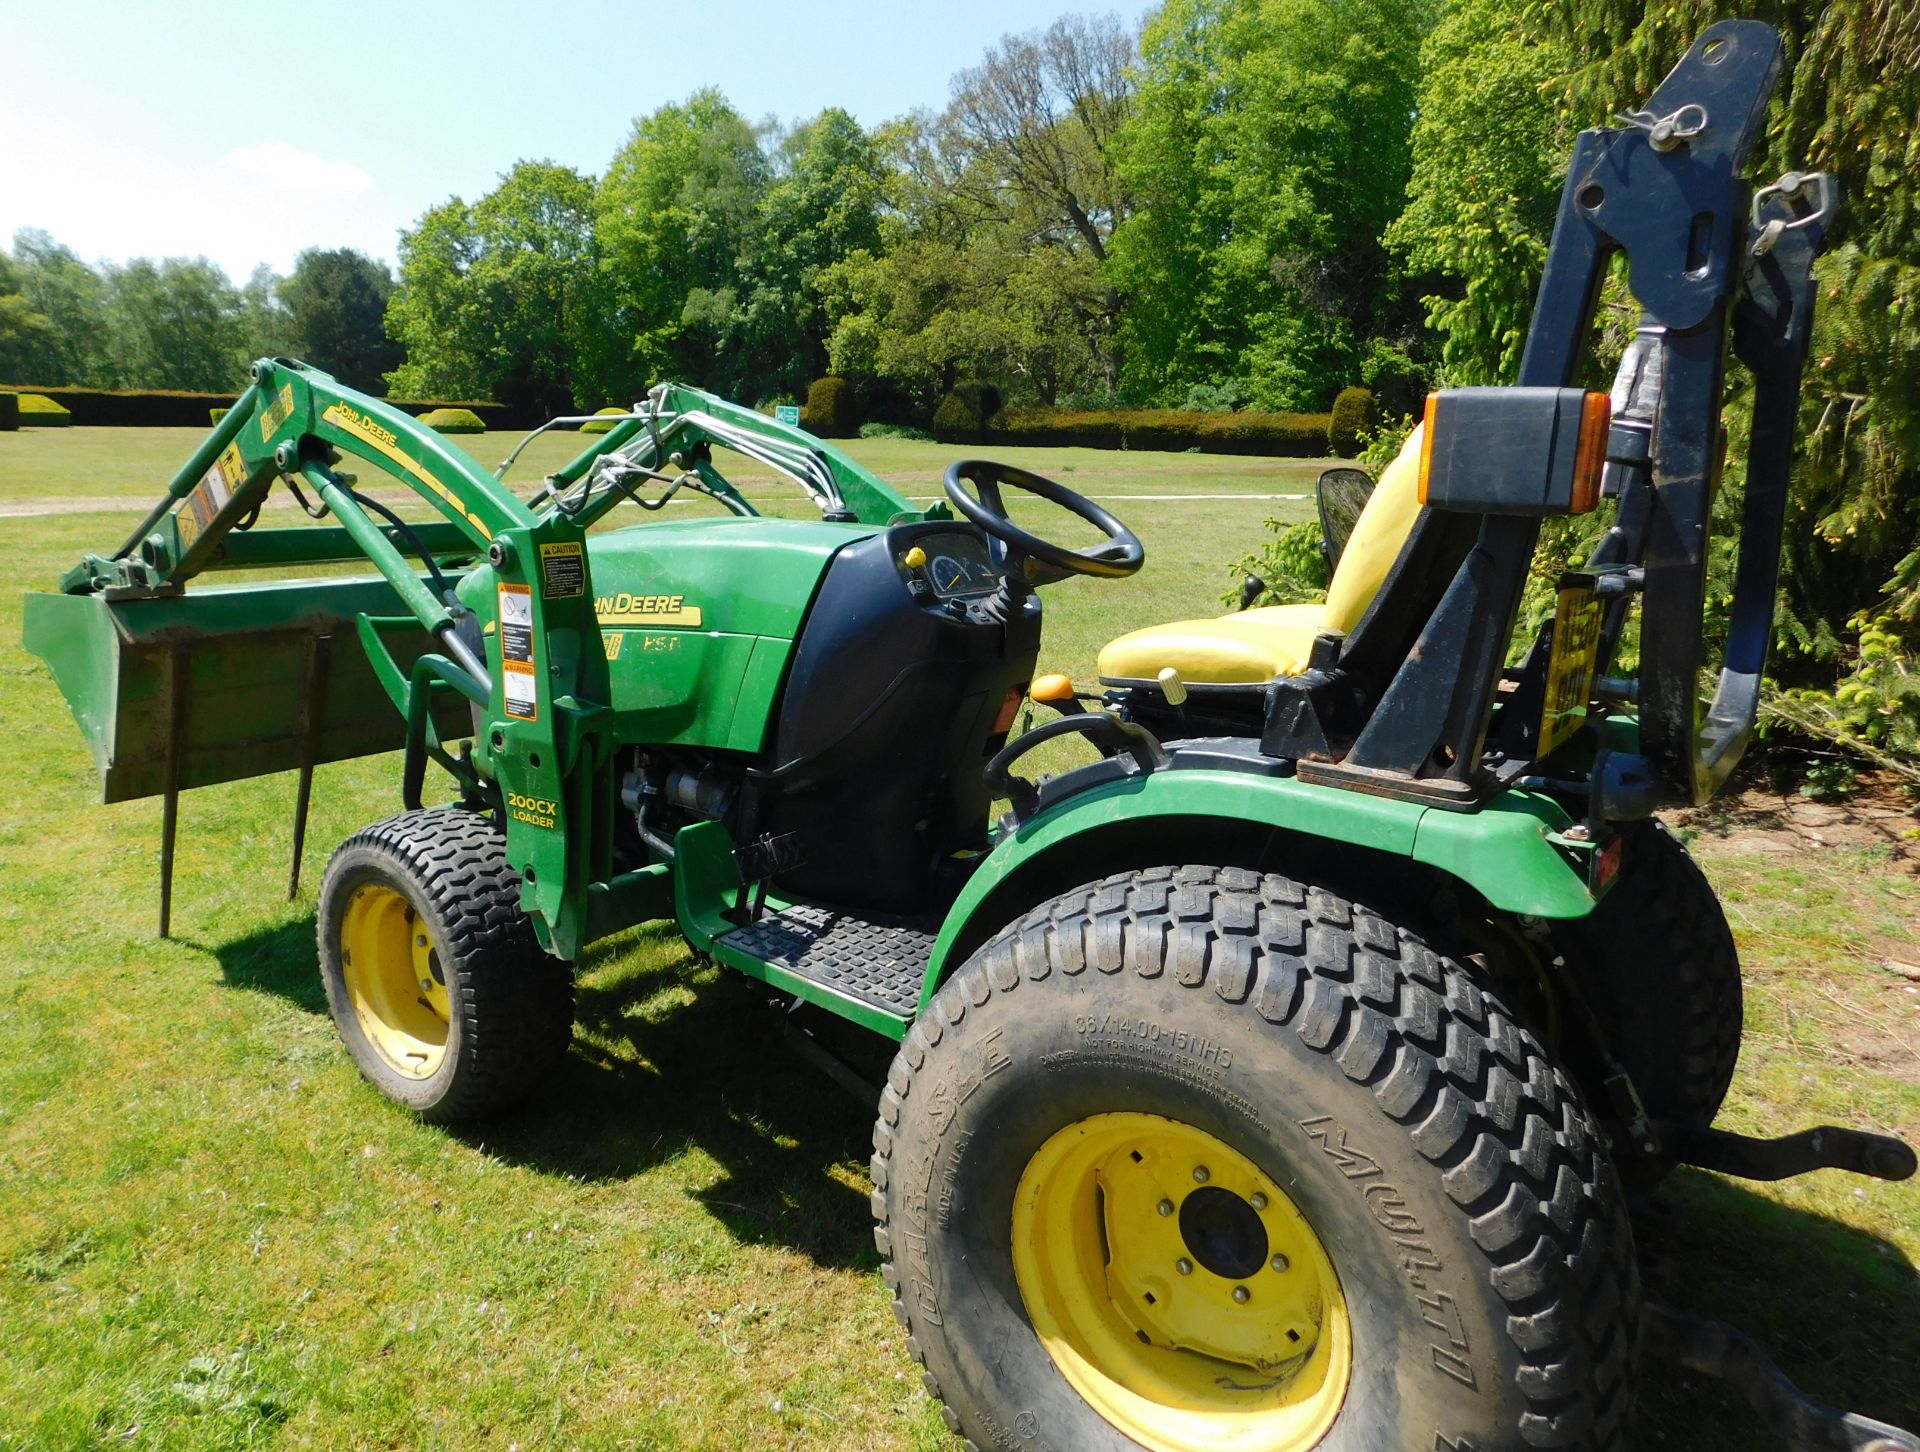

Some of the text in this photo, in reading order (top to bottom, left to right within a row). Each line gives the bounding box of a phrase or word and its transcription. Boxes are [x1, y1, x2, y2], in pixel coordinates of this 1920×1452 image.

[361, 415, 398, 448] DEERE
[551, 544, 580, 555] CAUTION
[593, 593, 684, 614] HN DEERE
[508, 792, 556, 816] 200CX
[513, 809, 554, 829] LOADER
[1084, 1035, 1221, 1080] NOT FOR HIGHWAY SERVICE
[943, 1166, 958, 1182] IN
[937, 1186, 953, 1230] MADE
[1298, 1115, 1479, 1393] MULTI
